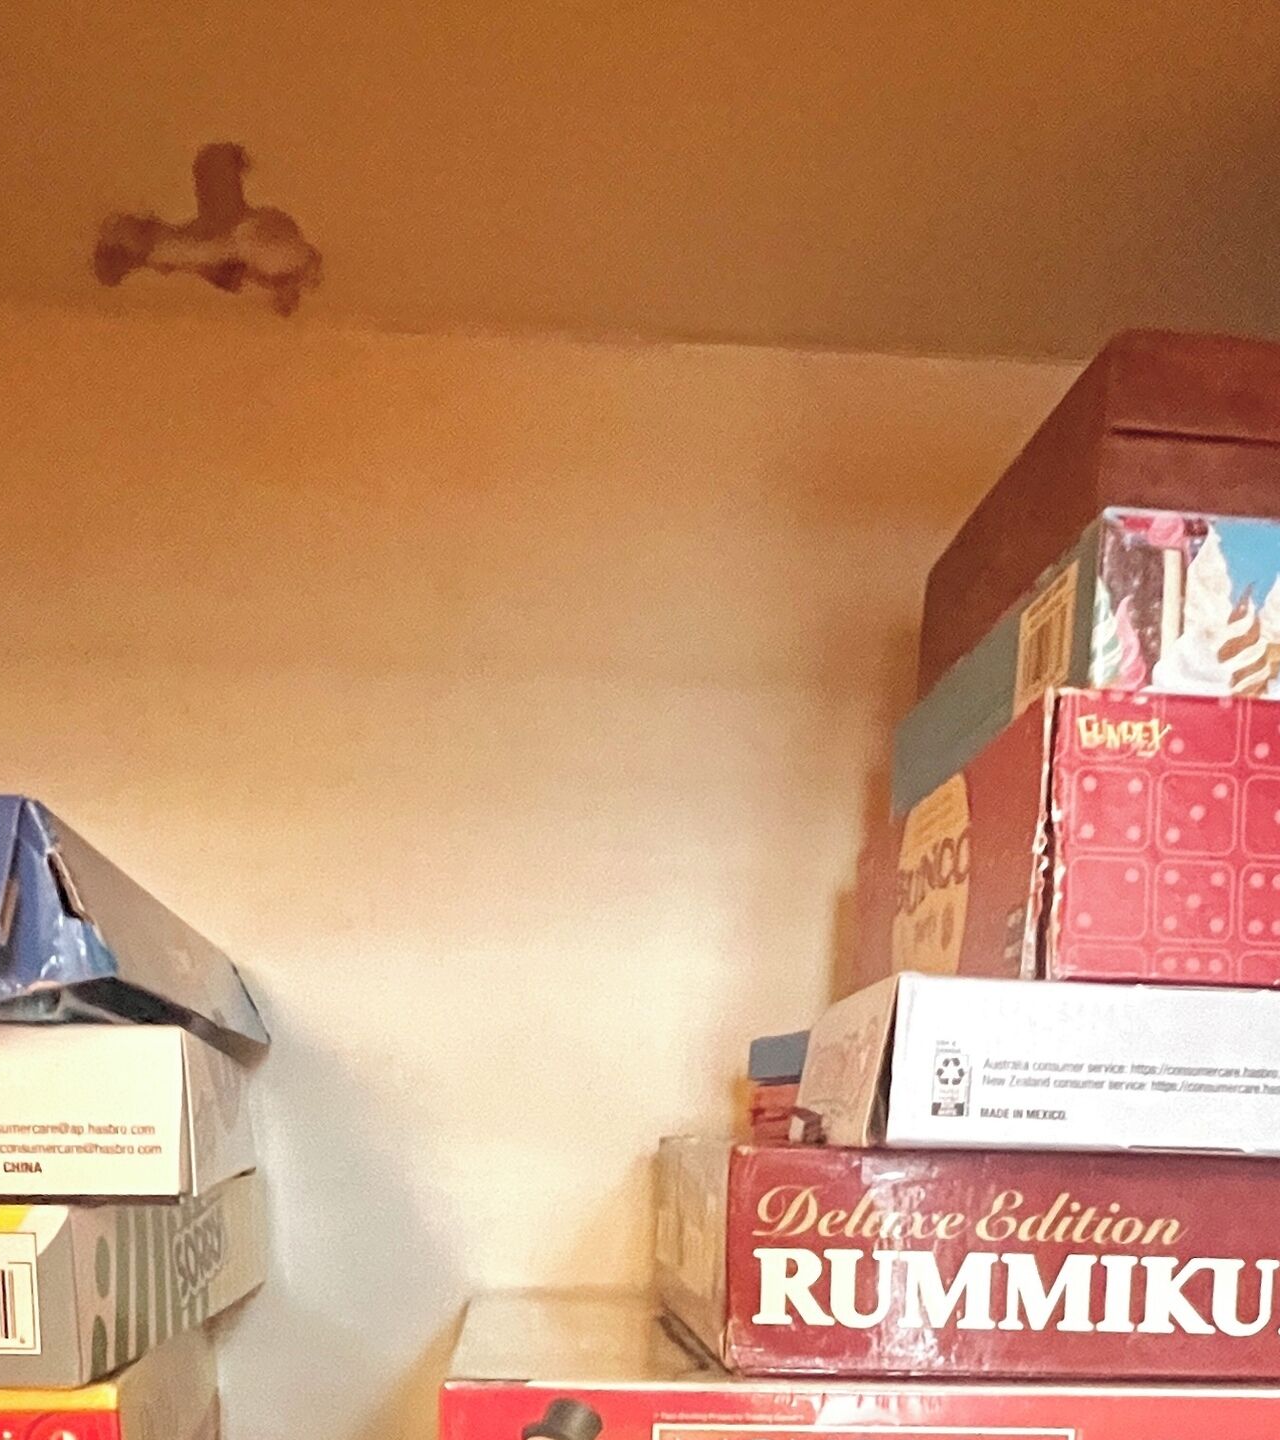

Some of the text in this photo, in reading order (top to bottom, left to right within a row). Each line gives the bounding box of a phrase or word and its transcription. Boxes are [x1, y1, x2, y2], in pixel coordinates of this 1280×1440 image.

[982, 1074, 1006, 1086] New
[1008, 1075, 1051, 1088] Zealand
[980, 1107, 1009, 1119] MADE
[1013, 1108, 1024, 1119] IN
[3, 1161, 43, 1174] CHINA
[752, 1183, 1190, 1247] Deluxe Edition
